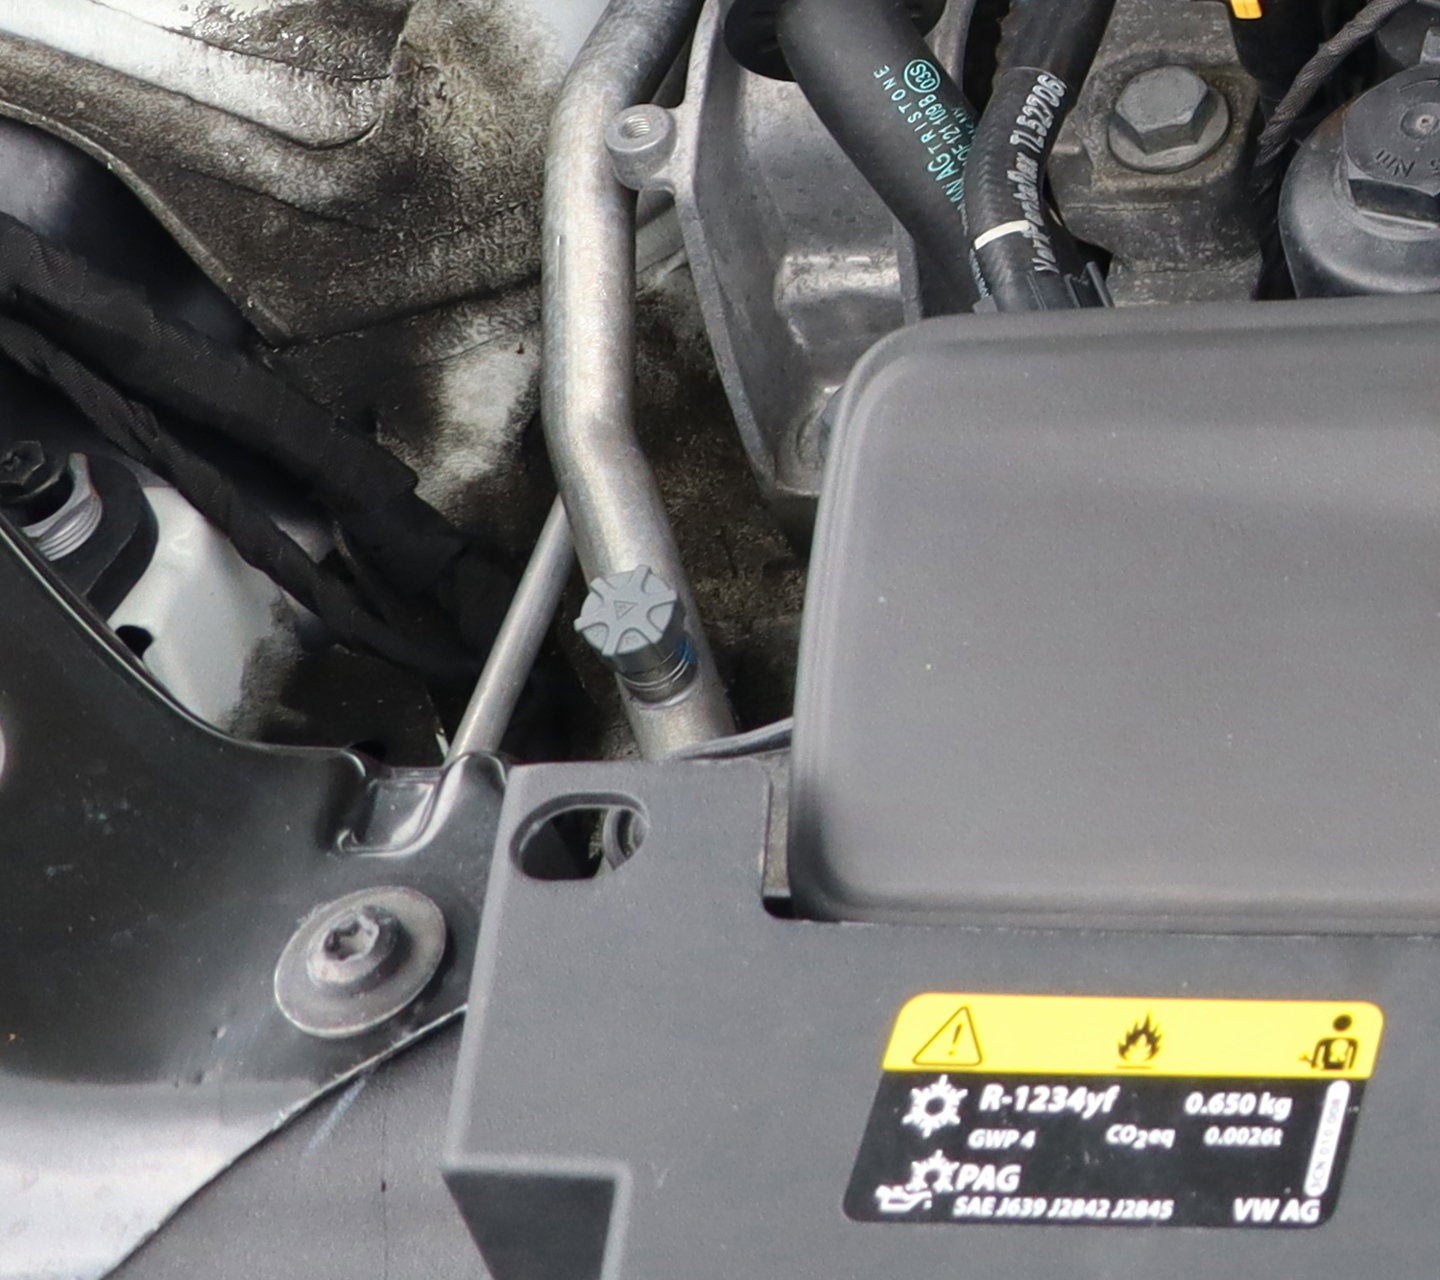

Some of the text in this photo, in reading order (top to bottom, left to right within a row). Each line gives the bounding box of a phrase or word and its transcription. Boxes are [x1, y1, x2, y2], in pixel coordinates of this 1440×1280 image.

[873, 65, 957, 181] AG TRISTONE
[925, 104, 948, 125] 109
[941, 124, 963, 145] 121
[978, 1083, 1293, 1121] R-1234yf 0.650 kg
[968, 1130, 1019, 1148] GWP
[1022, 1131, 1036, 1148] 4
[1203, 1128, 1284, 1147] 0.0026t
[955, 1165, 1021, 1192] PAG
[953, 1197, 1173, 1220] SAE J639 J2842 J2845
[1233, 1200, 1320, 1222] VW AG
